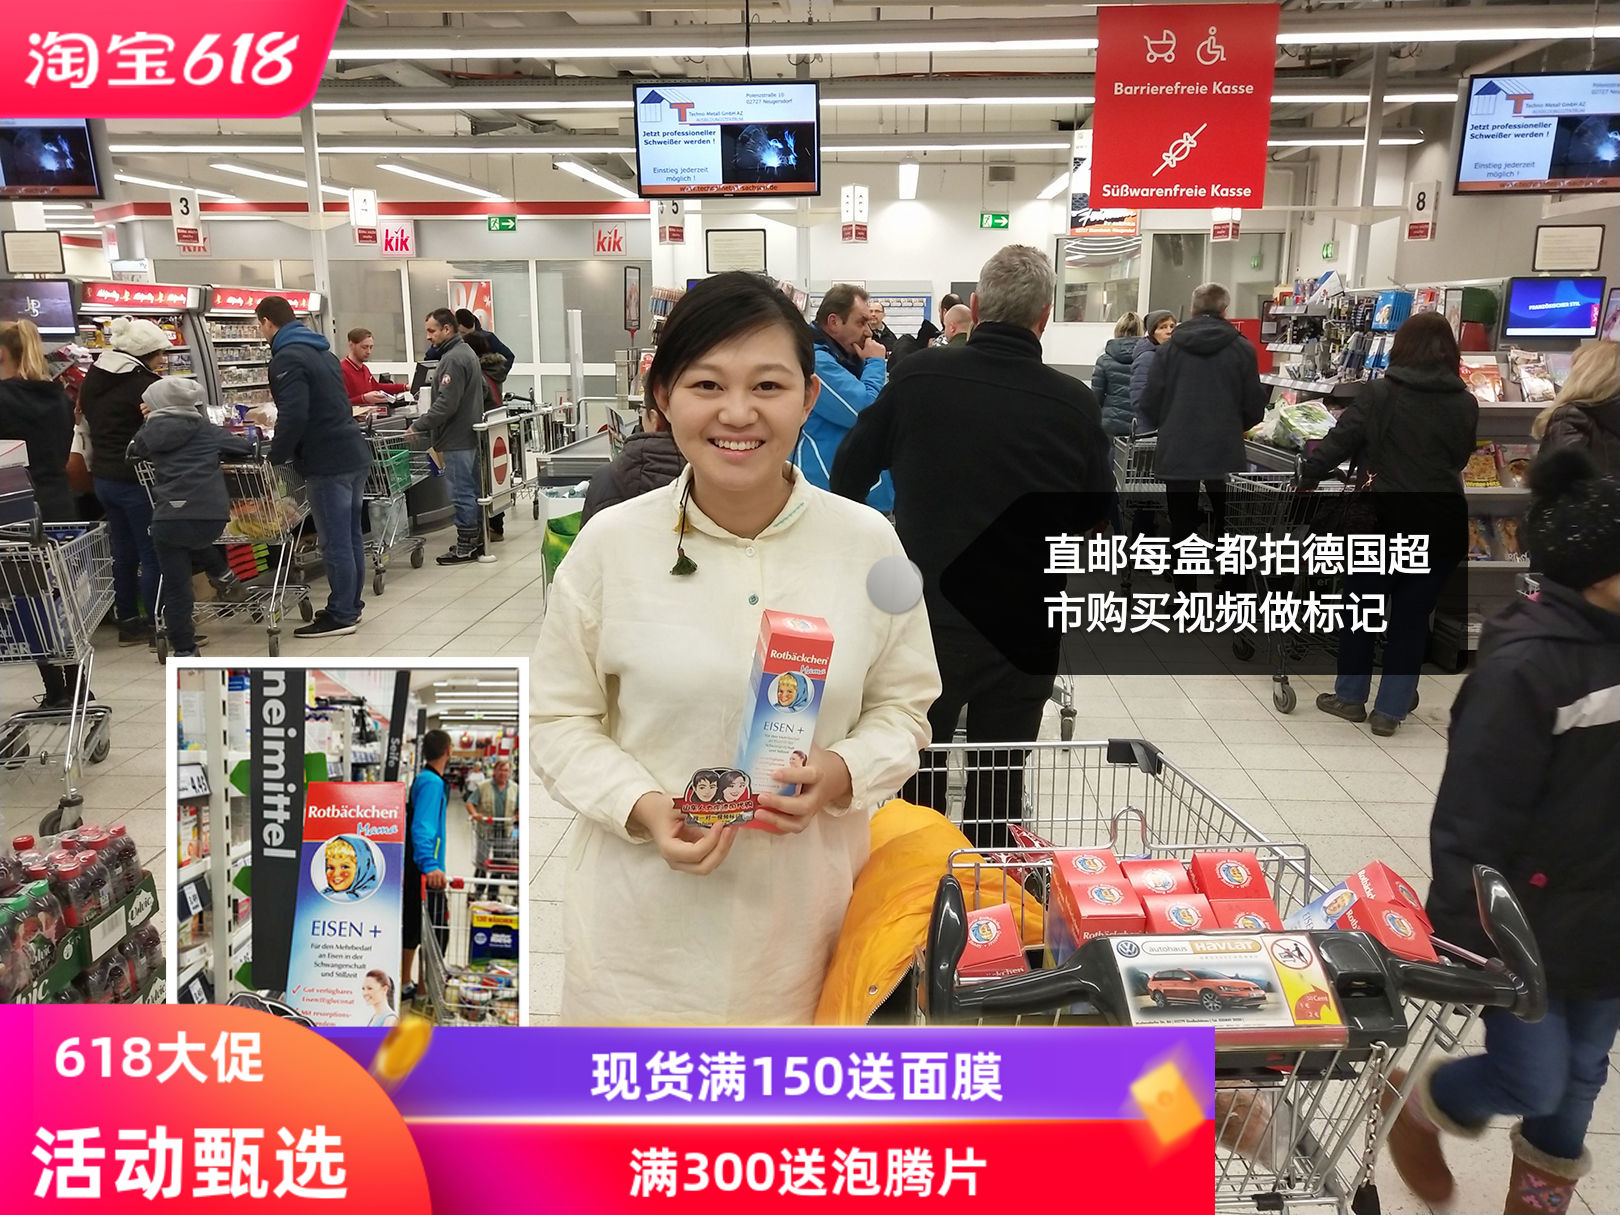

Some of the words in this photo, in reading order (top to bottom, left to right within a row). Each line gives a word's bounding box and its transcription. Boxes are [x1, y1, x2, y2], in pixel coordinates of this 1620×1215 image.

[1113, 81, 1208, 95] Barrierefreie
[1212, 80, 1254, 95] Kasse
[642, 130, 660, 138] Jetzt
[661, 129, 717, 138] professioneller
[1469, 123, 1490, 131] Jetzt
[1491, 121, 1552, 132] professioneller
[643, 138, 682, 146] Schweißer
[1469, 132, 1512, 140] Schweißer
[1513, 131, 1544, 139] werden
[1101, 184, 1207, 197] Süßwarenfreie
[1210, 184, 1252, 197] Kasse
[179, 196, 190, 216] 3
[1416, 191, 1427, 212] 8
[384, 227, 411, 252] kik
[596, 227, 624, 252] kik
[770, 648, 829, 665] Rotbäckchen
[763, 721, 795, 733] EISEN
[308, 804, 398, 819] Rotbäckchen
[356, 821, 399, 836] Mama
[311, 919, 363, 937] EISEN
[1149, 945, 1188, 953] autohaus
